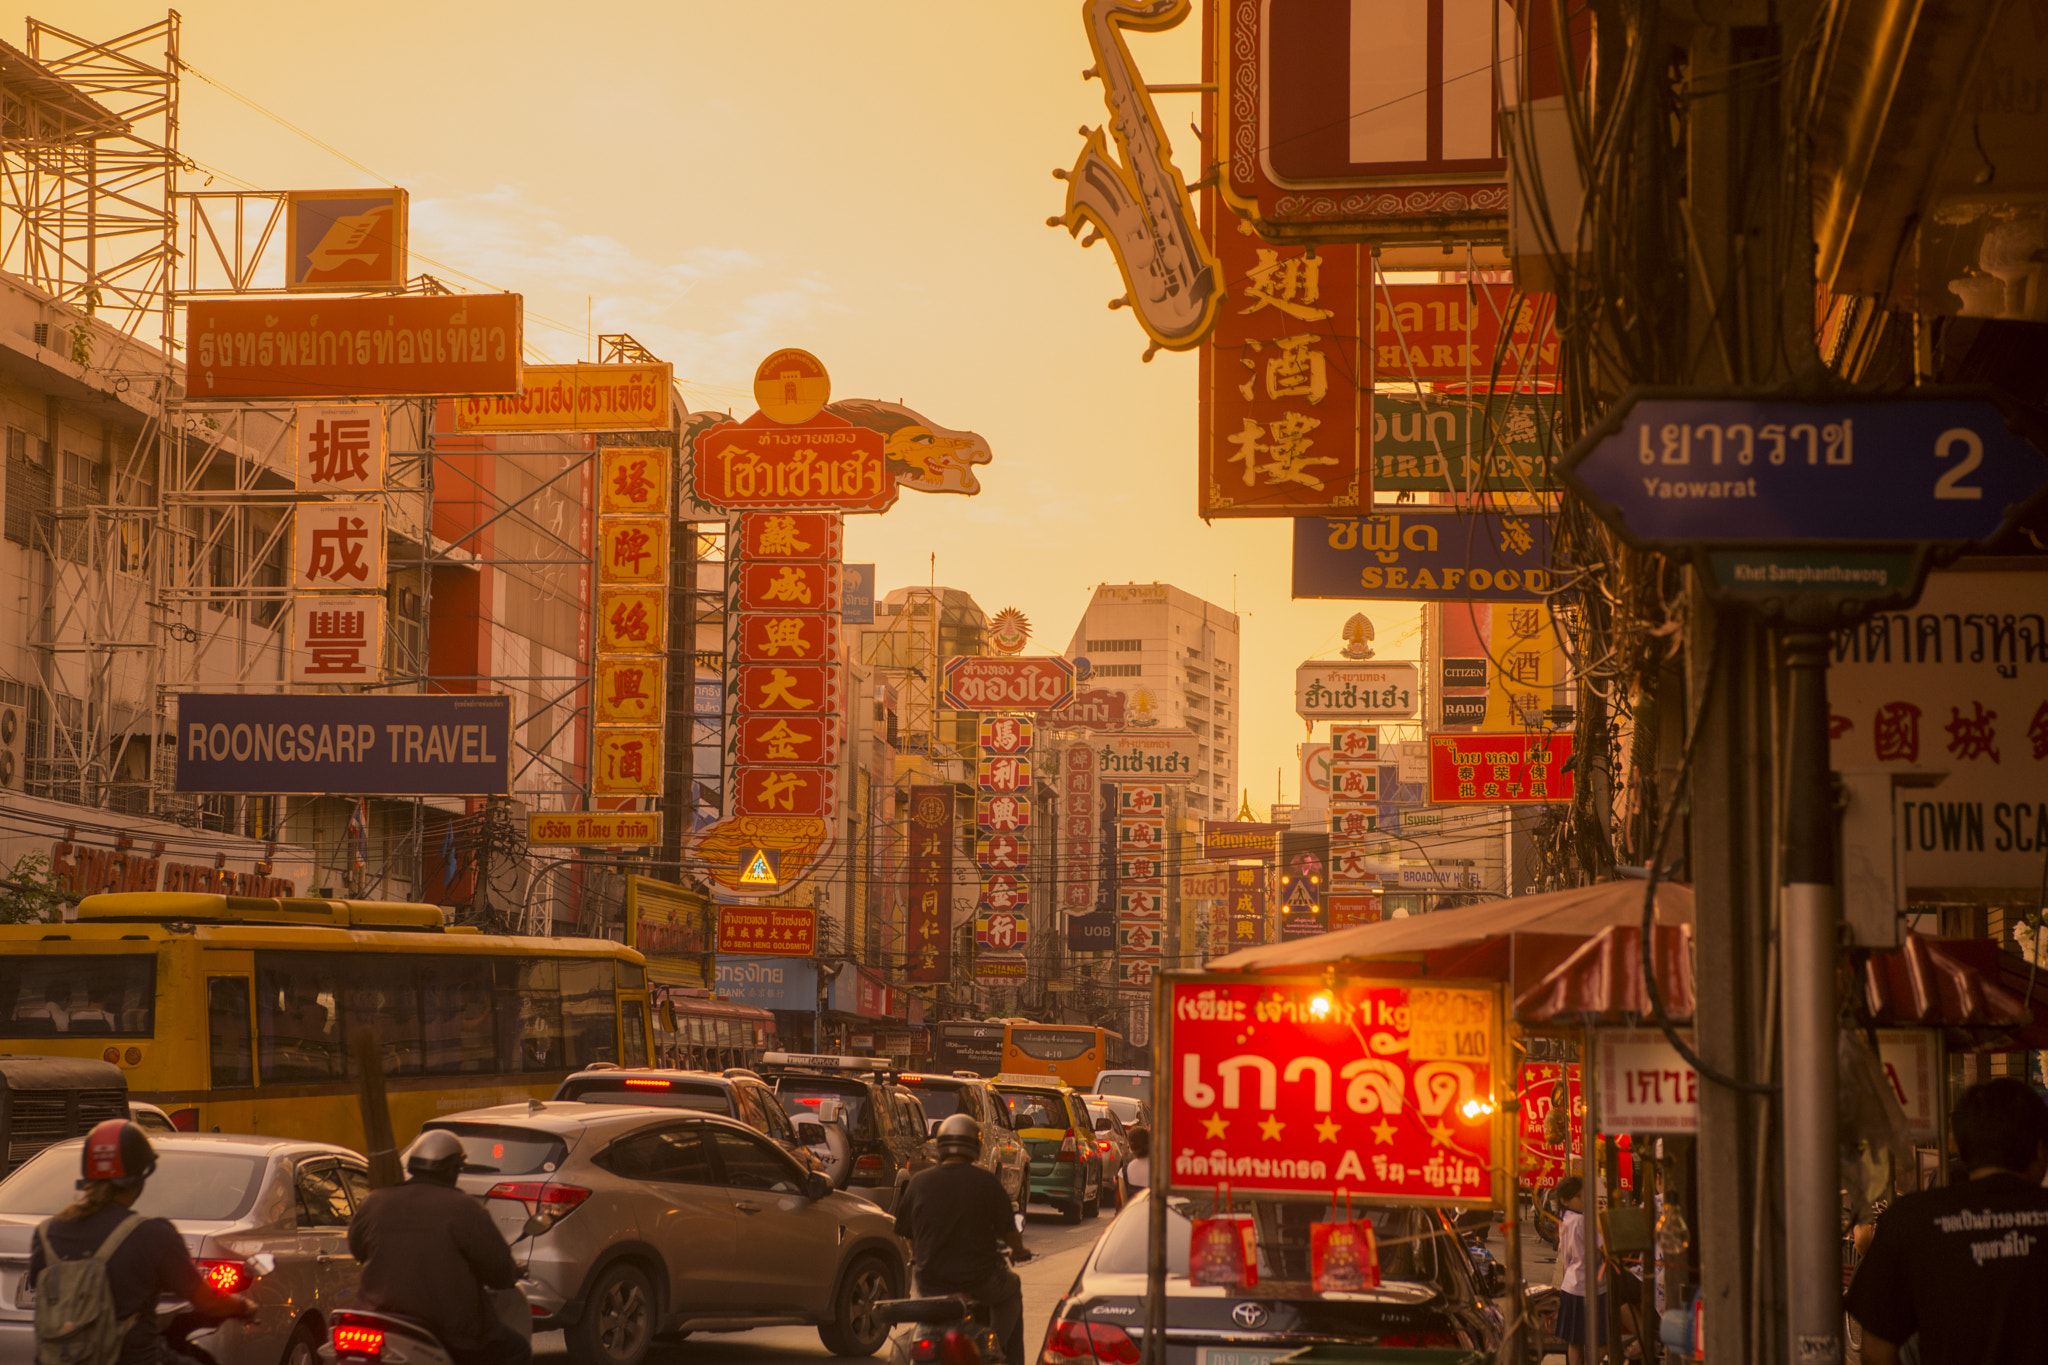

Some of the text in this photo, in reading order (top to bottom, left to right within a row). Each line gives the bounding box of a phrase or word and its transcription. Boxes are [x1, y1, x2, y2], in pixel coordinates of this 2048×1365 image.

[200, 301, 506, 388] รุ่งทรัพย์การท่องเที่ยว
[1227, 248, 1340, 491] 翅酒樓
[578, 374, 657, 412] ตราเจดีย์
[758, 432, 857, 445] ห้างขายทอง
[1638, 419, 1853, 466] เยาวราช
[1461, 455, 1558, 478] NEST
[1933, 427, 1983, 499] 2
[1643, 477, 1757, 499] Yaowarat
[303, 418, 372, 676] 振成豐
[1361, 566, 1551, 591] SEAFOOD
[1734, 563, 1887, 586] Khet Samphanthawong
[756, 515, 815, 811] 蘇成興大金行
[963, 660, 1014, 675] ห้างทอง
[1445, 668, 1484, 677] CITIZEN
[1305, 678, 1410, 709] ฮั่วเซ่งเฮง
[1445, 704, 1484, 714] RADO
[188, 722, 497, 763] ROONGSARP TRAVEL
[1448, 746, 1481, 765] ไทย
[1485, 751, 1519, 765] หลง
[1459, 782, 1547, 797] 批发干果
[537, 818, 571, 840] บริษัท
[615, 816, 648, 839] จำกัด
[989, 720, 1019, 946] 馬利興大金行
[1903, 801, 1985, 851] TOWN
[1128, 786, 1155, 983] 和成興大金行
[1403, 871, 1451, 883] BROADWAY
[1084, 926, 1111, 937] UOB
[723, 940, 732, 948] SO
[773, 942, 810, 950] GOLDSMITH
[976, 964, 1026, 976] EXCHANGE
[719, 987, 745, 997] BANK
[1044, 1050, 1062, 1058] 4-10
[1182, 1033, 1477, 1117] เกาลัด
[1175, 1147, 1327, 1180] คัดพิเศษเกรด
[1335, 1150, 1366, 1181] A
[1092, 1305, 1136, 1315] CAMRY
